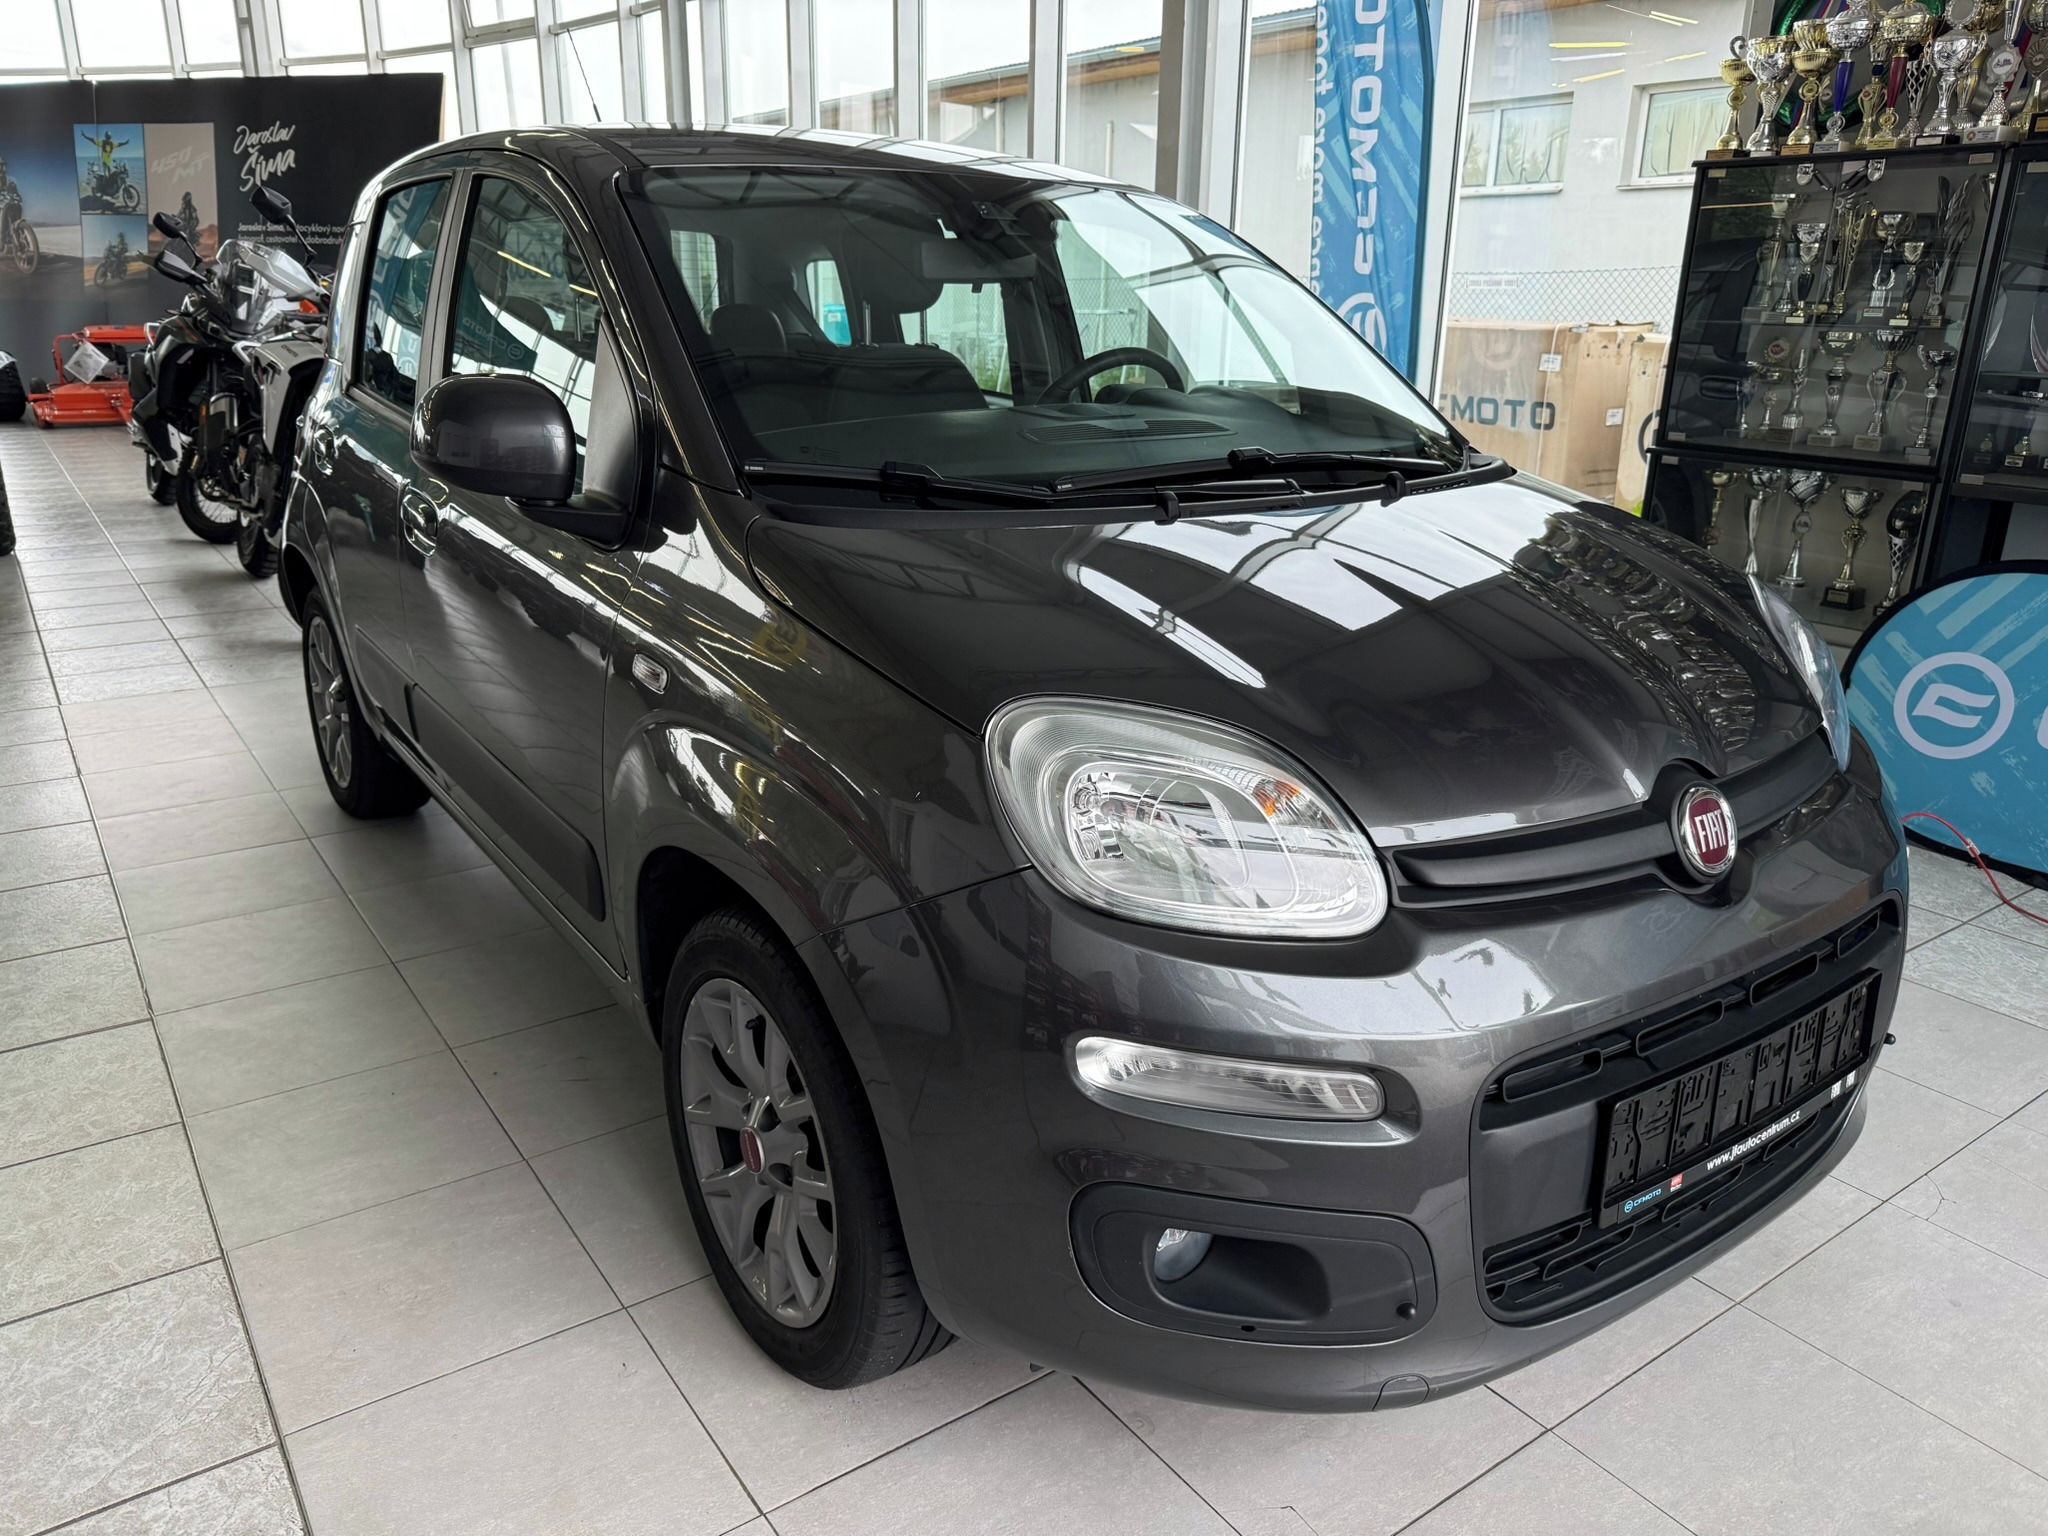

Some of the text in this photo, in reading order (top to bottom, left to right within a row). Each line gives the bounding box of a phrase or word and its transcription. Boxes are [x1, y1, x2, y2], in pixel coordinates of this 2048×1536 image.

[233, 120, 296, 154] Jaroslav
[239, 145, 296, 192] Šima
[1694, 809, 1727, 853] FIAT
[1633, 1188, 1662, 1207] CFMOTO
